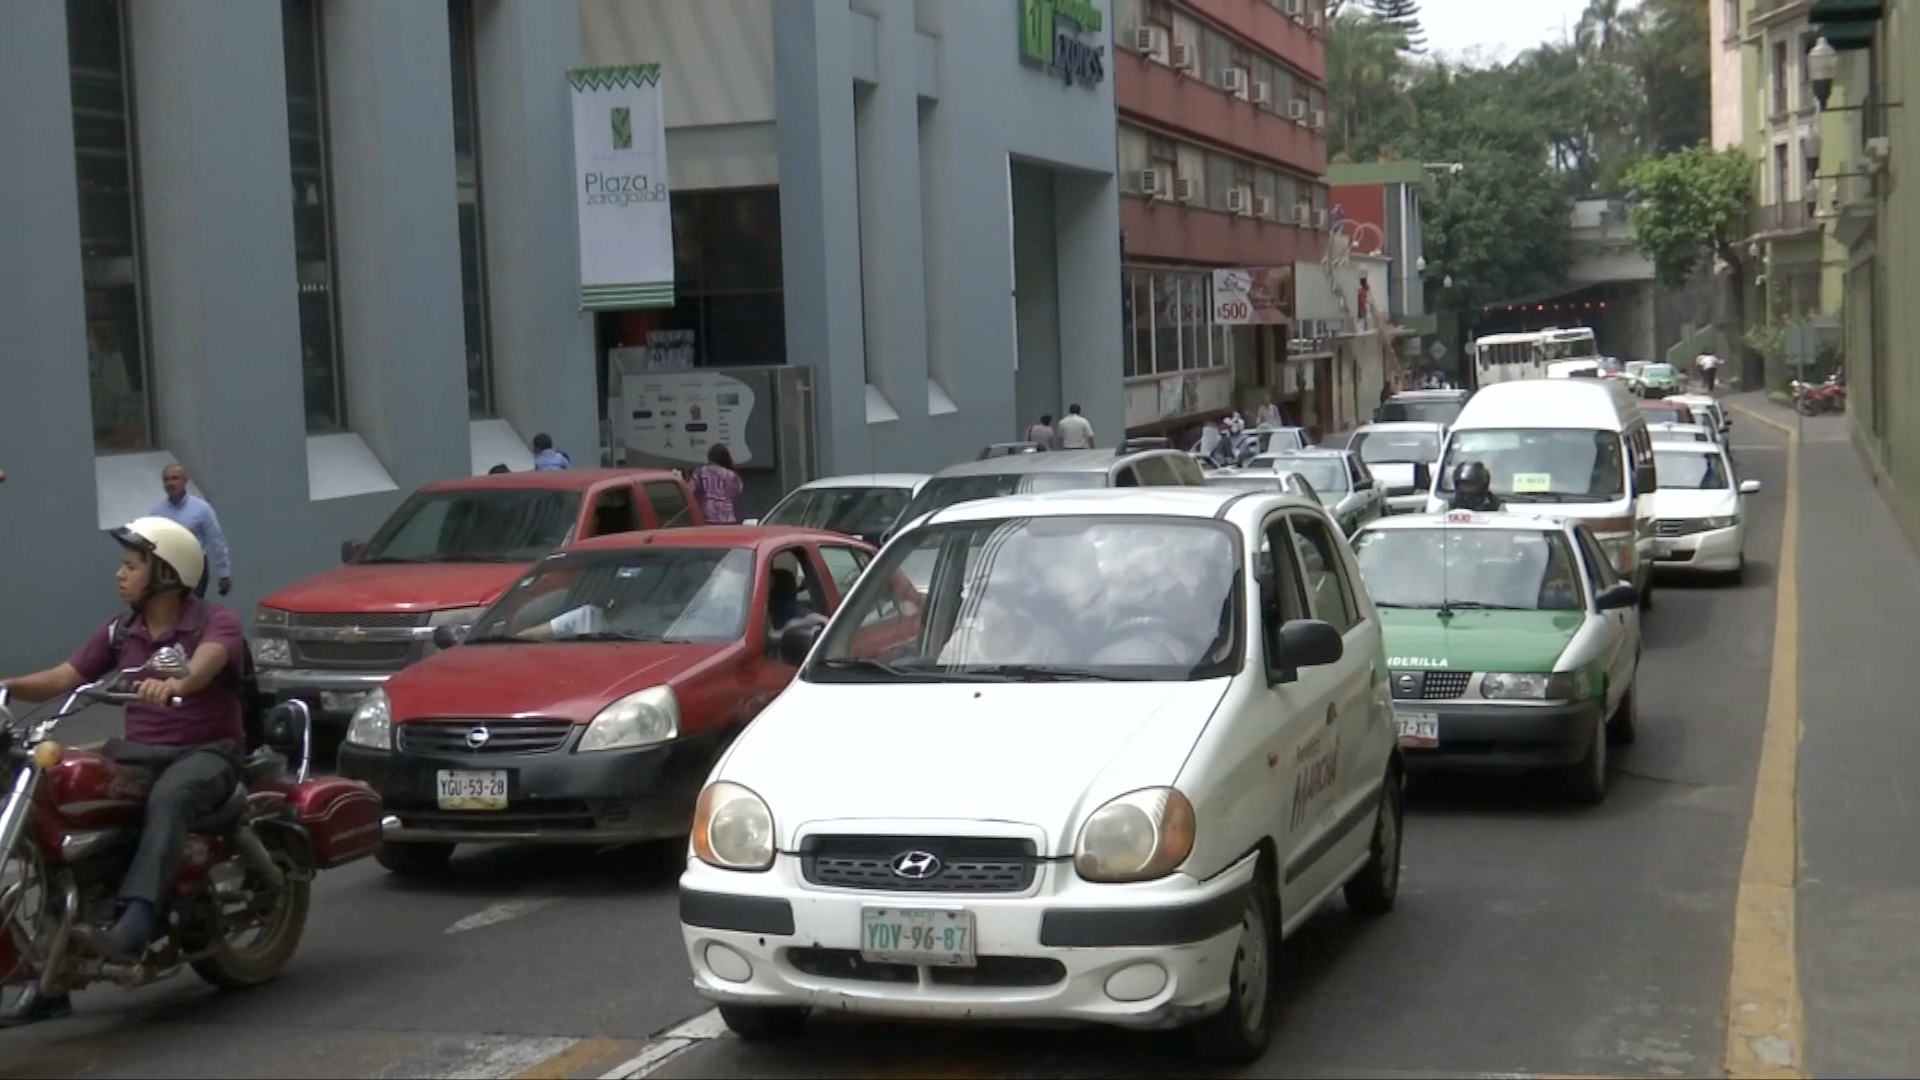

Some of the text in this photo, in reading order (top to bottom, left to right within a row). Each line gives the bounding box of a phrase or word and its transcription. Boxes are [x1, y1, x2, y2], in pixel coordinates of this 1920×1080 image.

[585, 171, 648, 193] Plaza
[1448, 514, 1472, 523] TAXI
[441, 779, 505, 796] YGU-53-28
[867, 923, 967, 951] YDV-96-87
